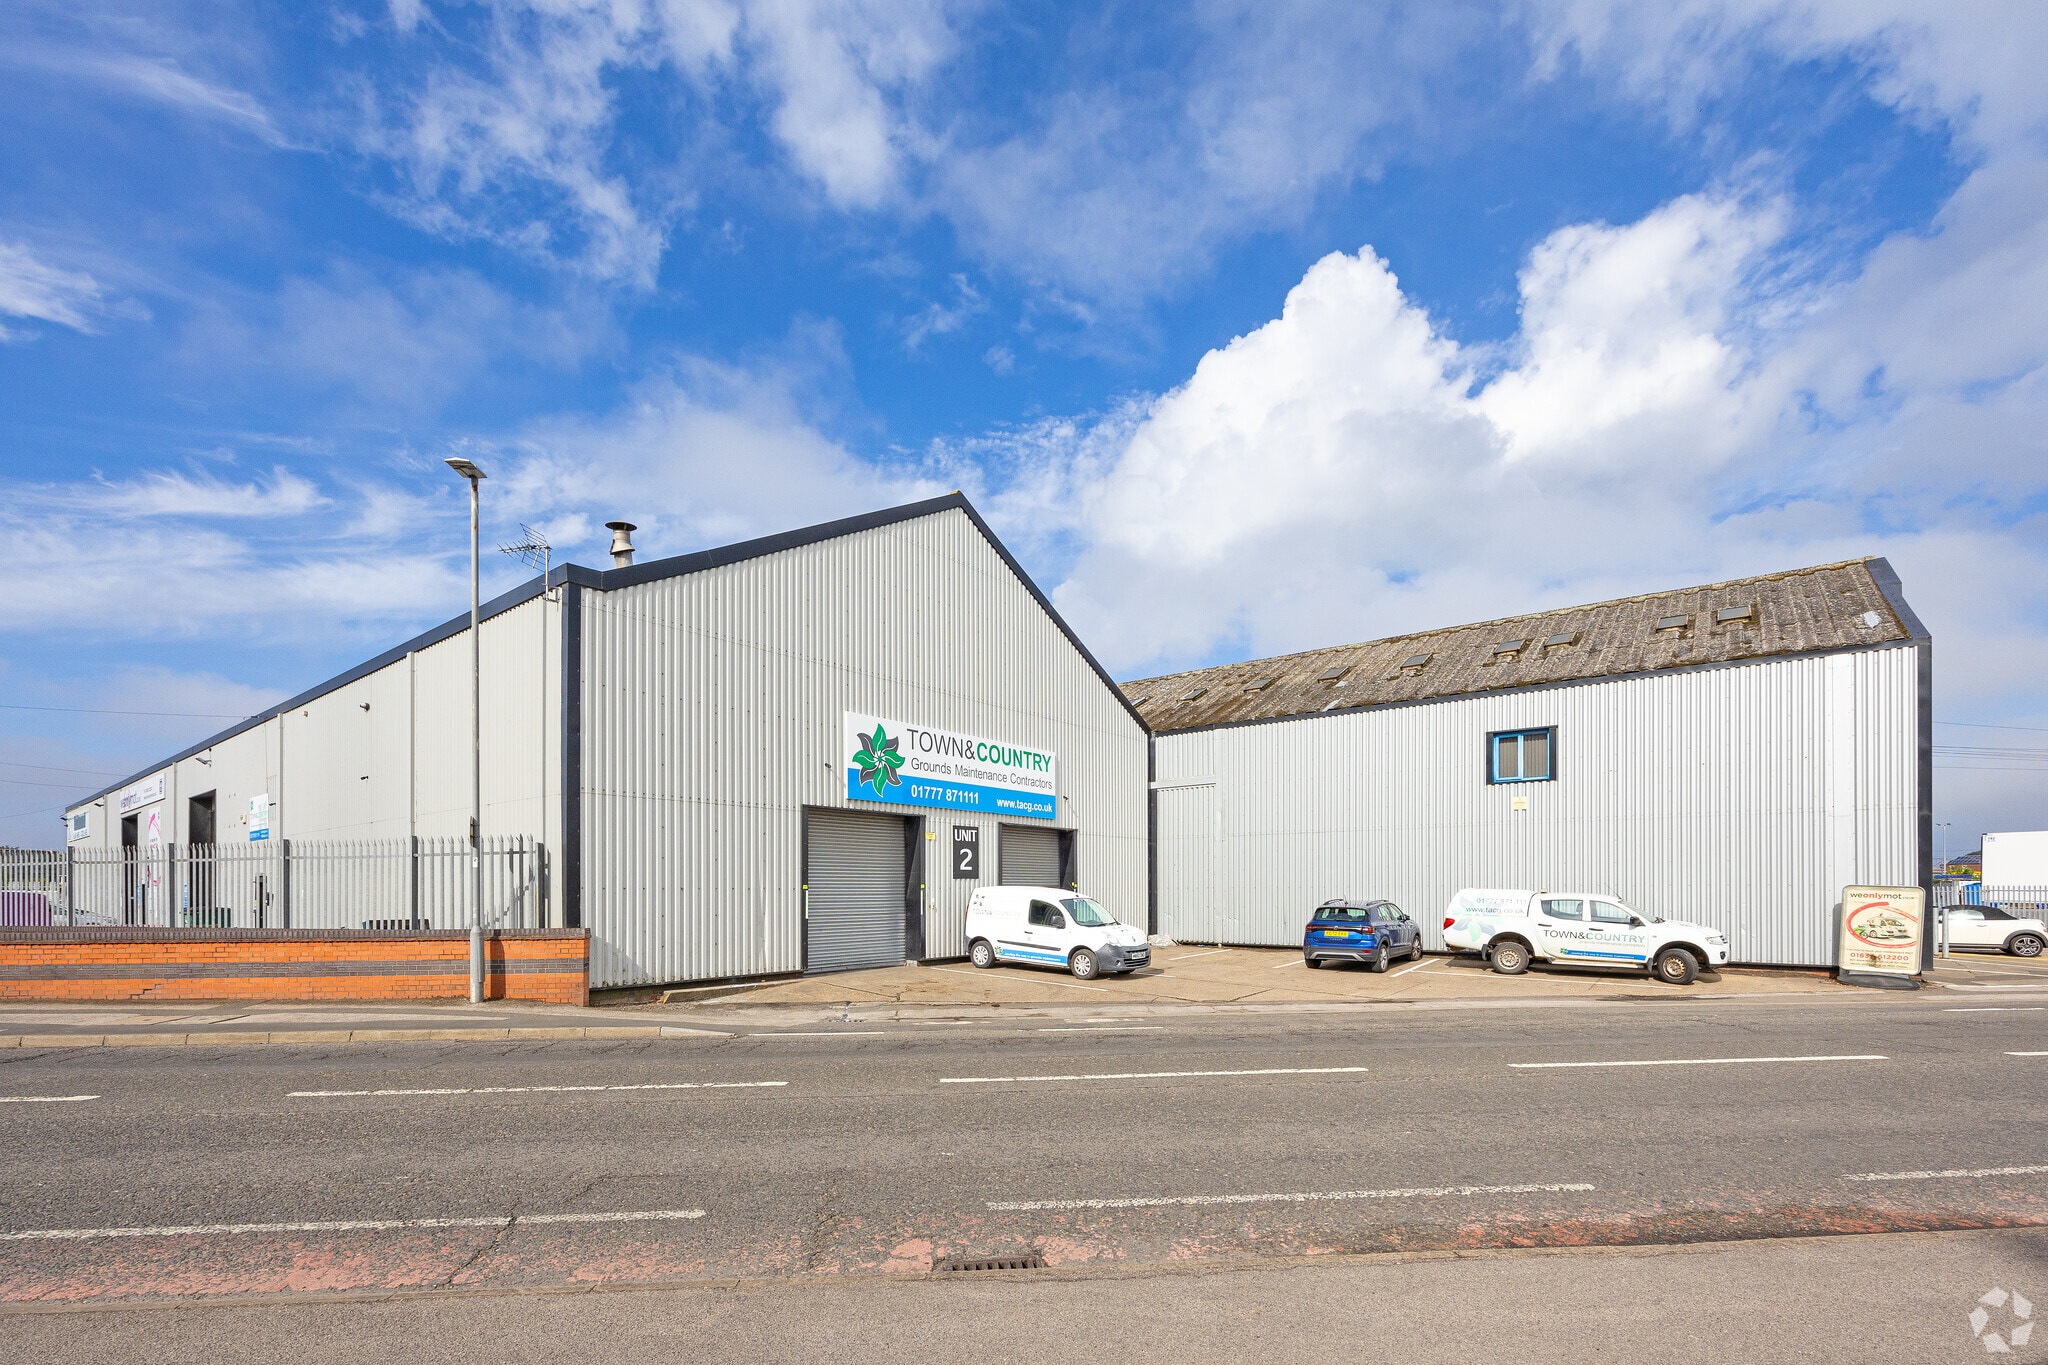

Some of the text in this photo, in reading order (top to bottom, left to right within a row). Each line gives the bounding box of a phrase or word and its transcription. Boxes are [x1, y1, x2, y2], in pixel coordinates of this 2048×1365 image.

[907, 728, 1051, 773] TOWN&COUNTRY
[911, 757, 1053, 790] Grounds Maintenance Contractors
[911, 784, 1053, 813] 01777 871111 www.tacg.co.uk
[954, 828, 978, 842] UNIT
[960, 848, 973, 871] 2
[1543, 929, 1646, 943] TOWN&COUNTRY
